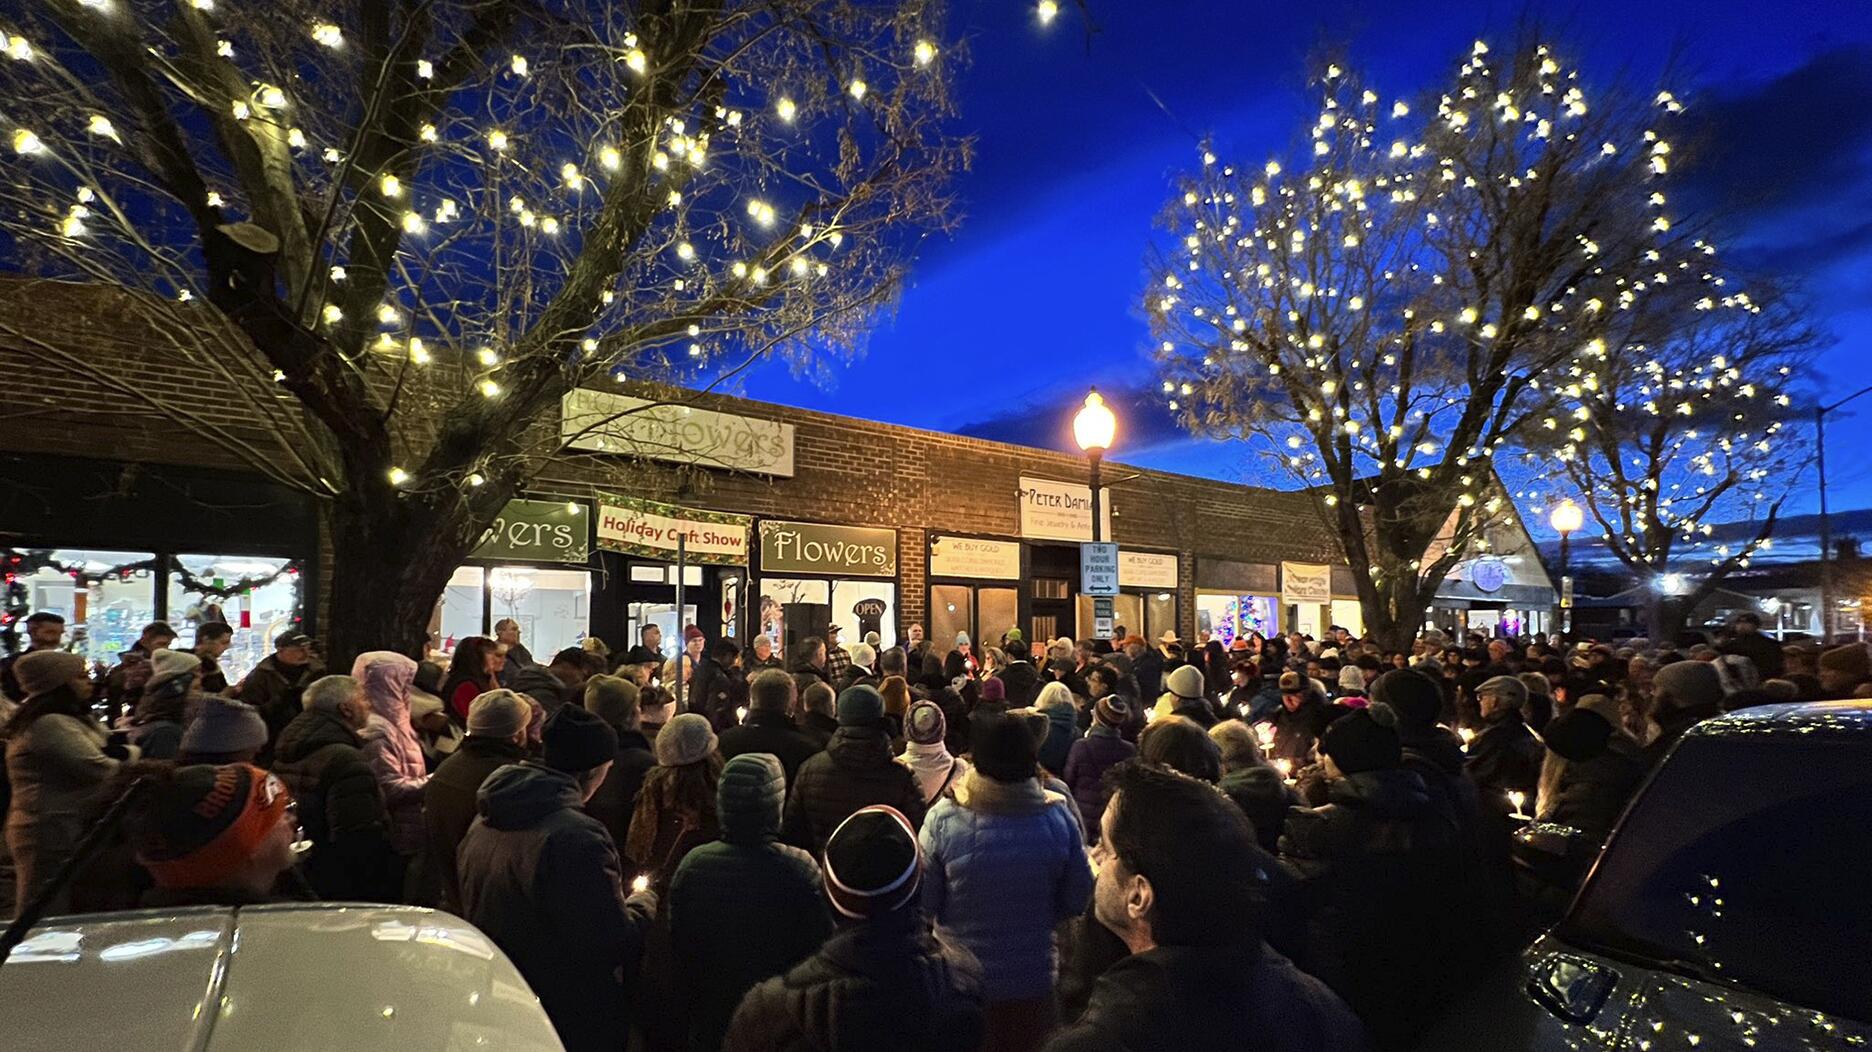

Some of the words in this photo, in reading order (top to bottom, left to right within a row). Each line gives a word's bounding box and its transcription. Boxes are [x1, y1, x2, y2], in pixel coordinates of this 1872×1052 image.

[1029, 488, 1062, 508] PETER
[603, 515, 663, 541] Holiday
[703, 531, 742, 547] Show
[774, 530, 887, 567] Flowers
[979, 544, 1000, 553] GOLD
[1092, 545, 1107, 553] TWO
[1090, 555, 1109, 563] HOUR
[1085, 565, 1115, 573] PARKING
[1091, 575, 1109, 583] ONLY
[855, 603, 883, 615] OPEN
